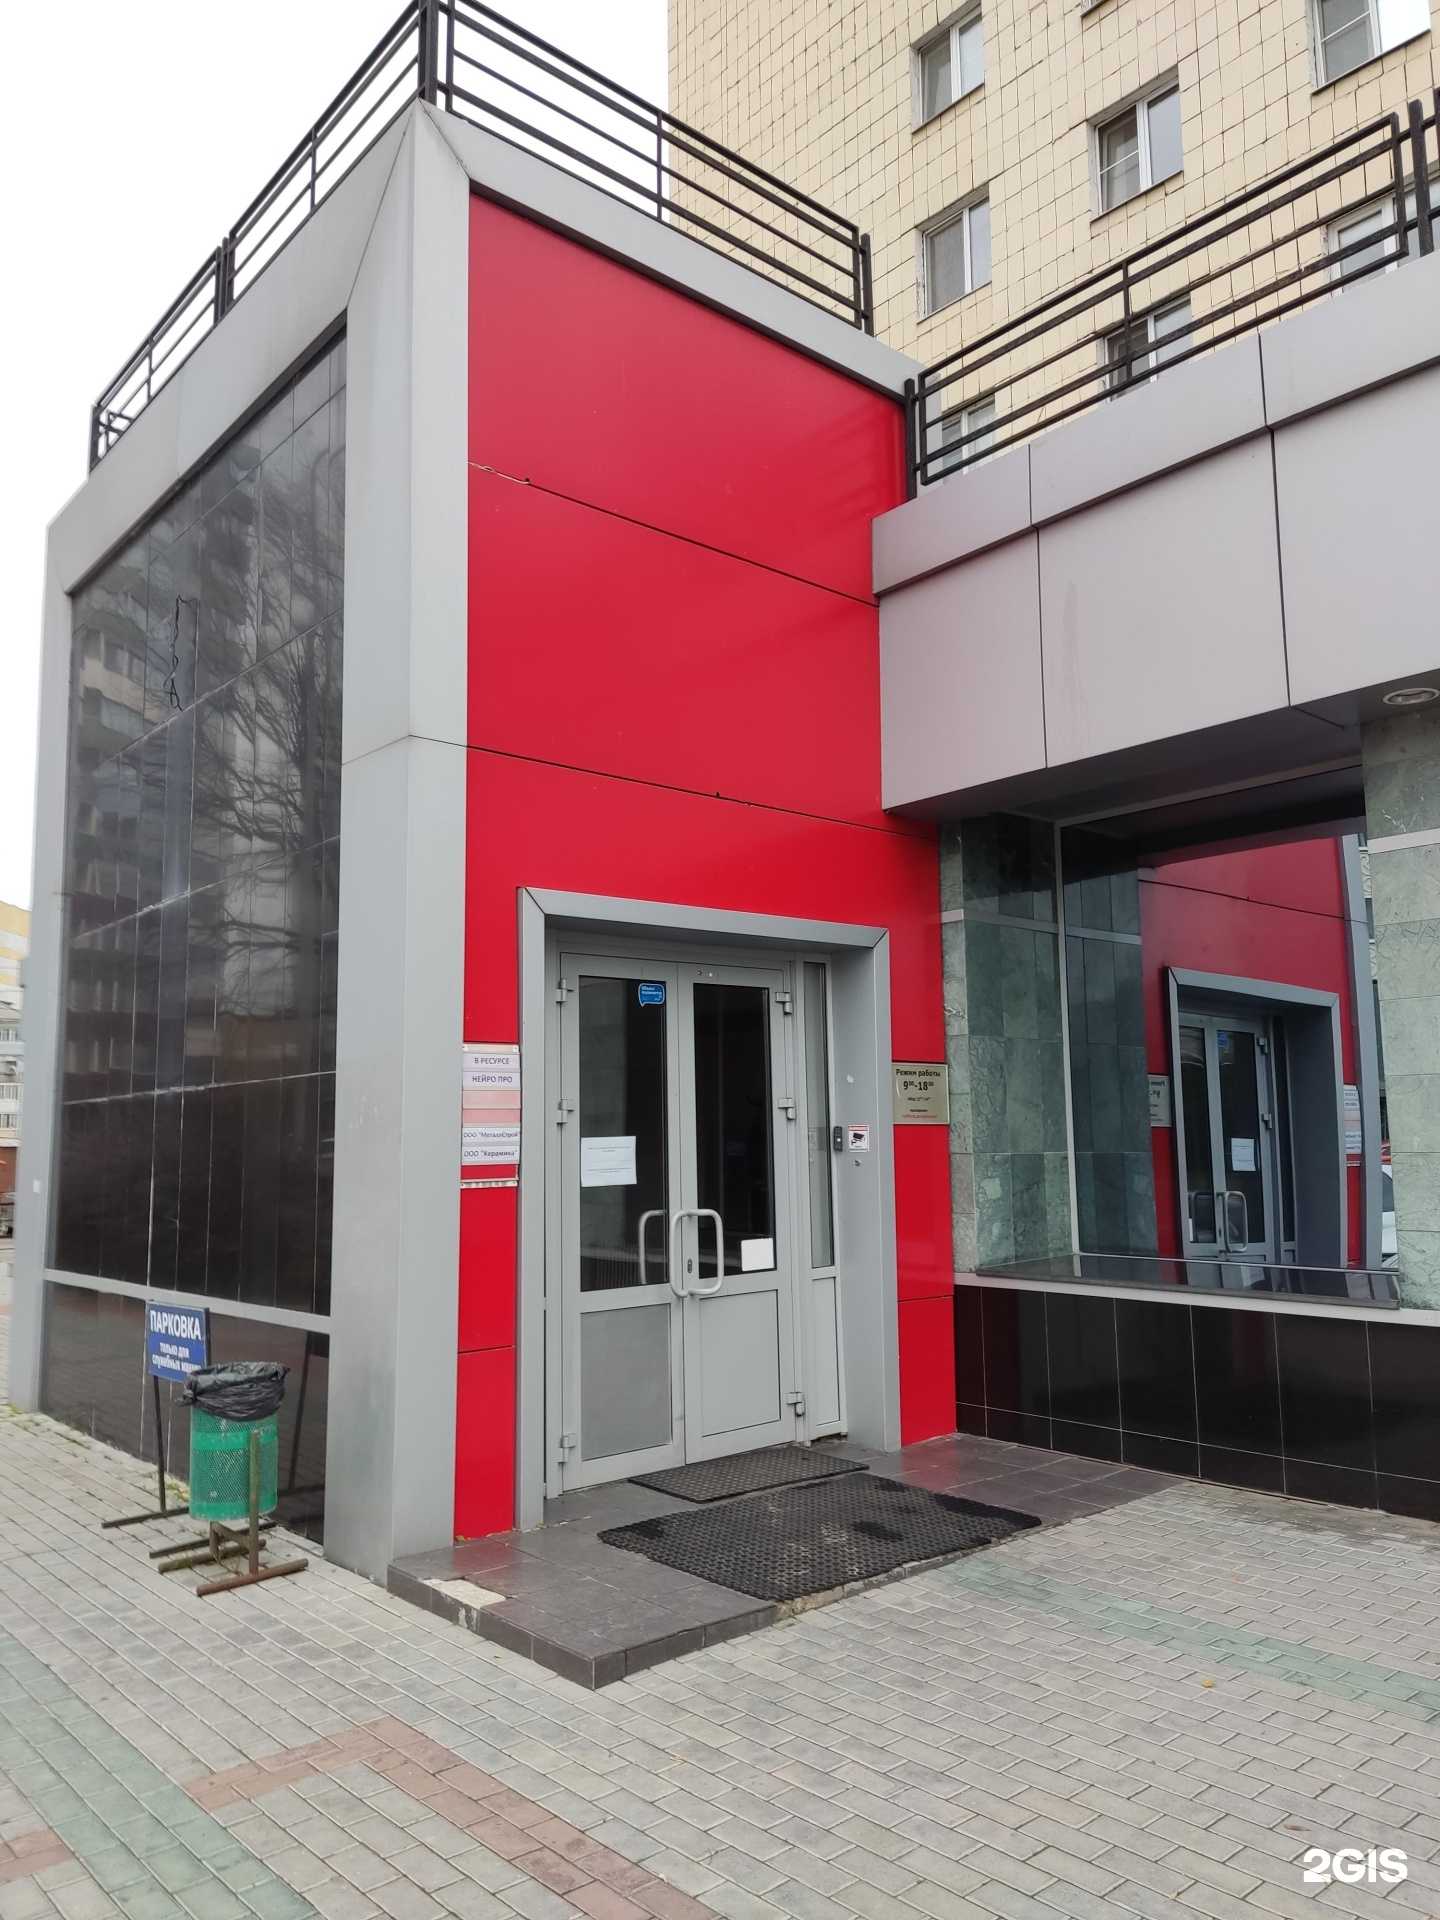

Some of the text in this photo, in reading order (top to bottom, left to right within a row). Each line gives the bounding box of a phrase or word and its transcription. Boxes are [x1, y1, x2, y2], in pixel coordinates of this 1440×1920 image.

[895, 1068, 941, 1078] Режим работы
[472, 1074, 513, 1083] НЕЙРО ПРО
[149, 1309, 202, 1341] ПАРКОВКА
